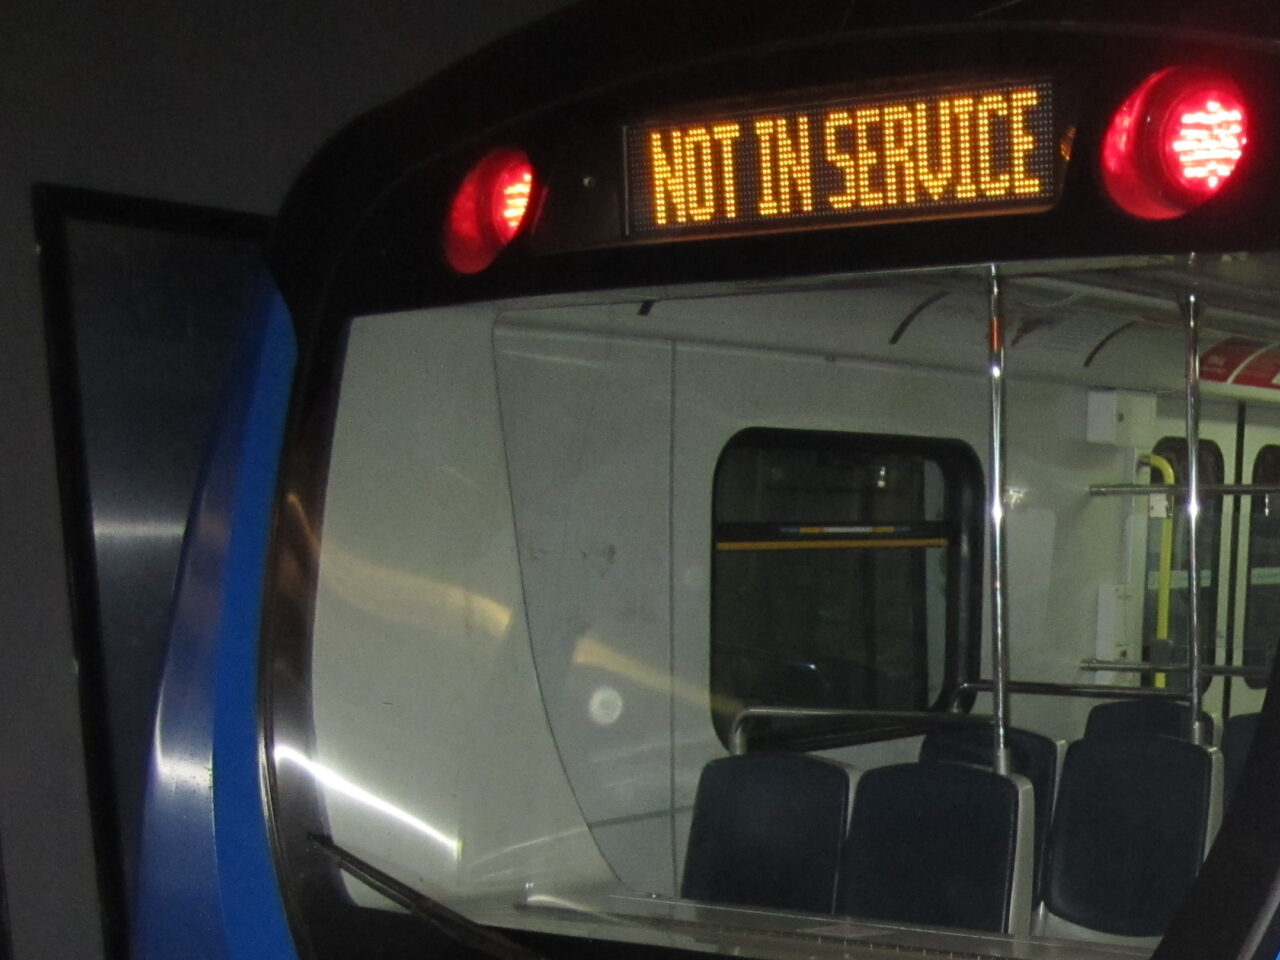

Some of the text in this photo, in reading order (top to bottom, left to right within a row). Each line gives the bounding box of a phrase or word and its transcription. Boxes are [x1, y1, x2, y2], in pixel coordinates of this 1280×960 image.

[651, 90, 1041, 225] NOT IN SERVICE
